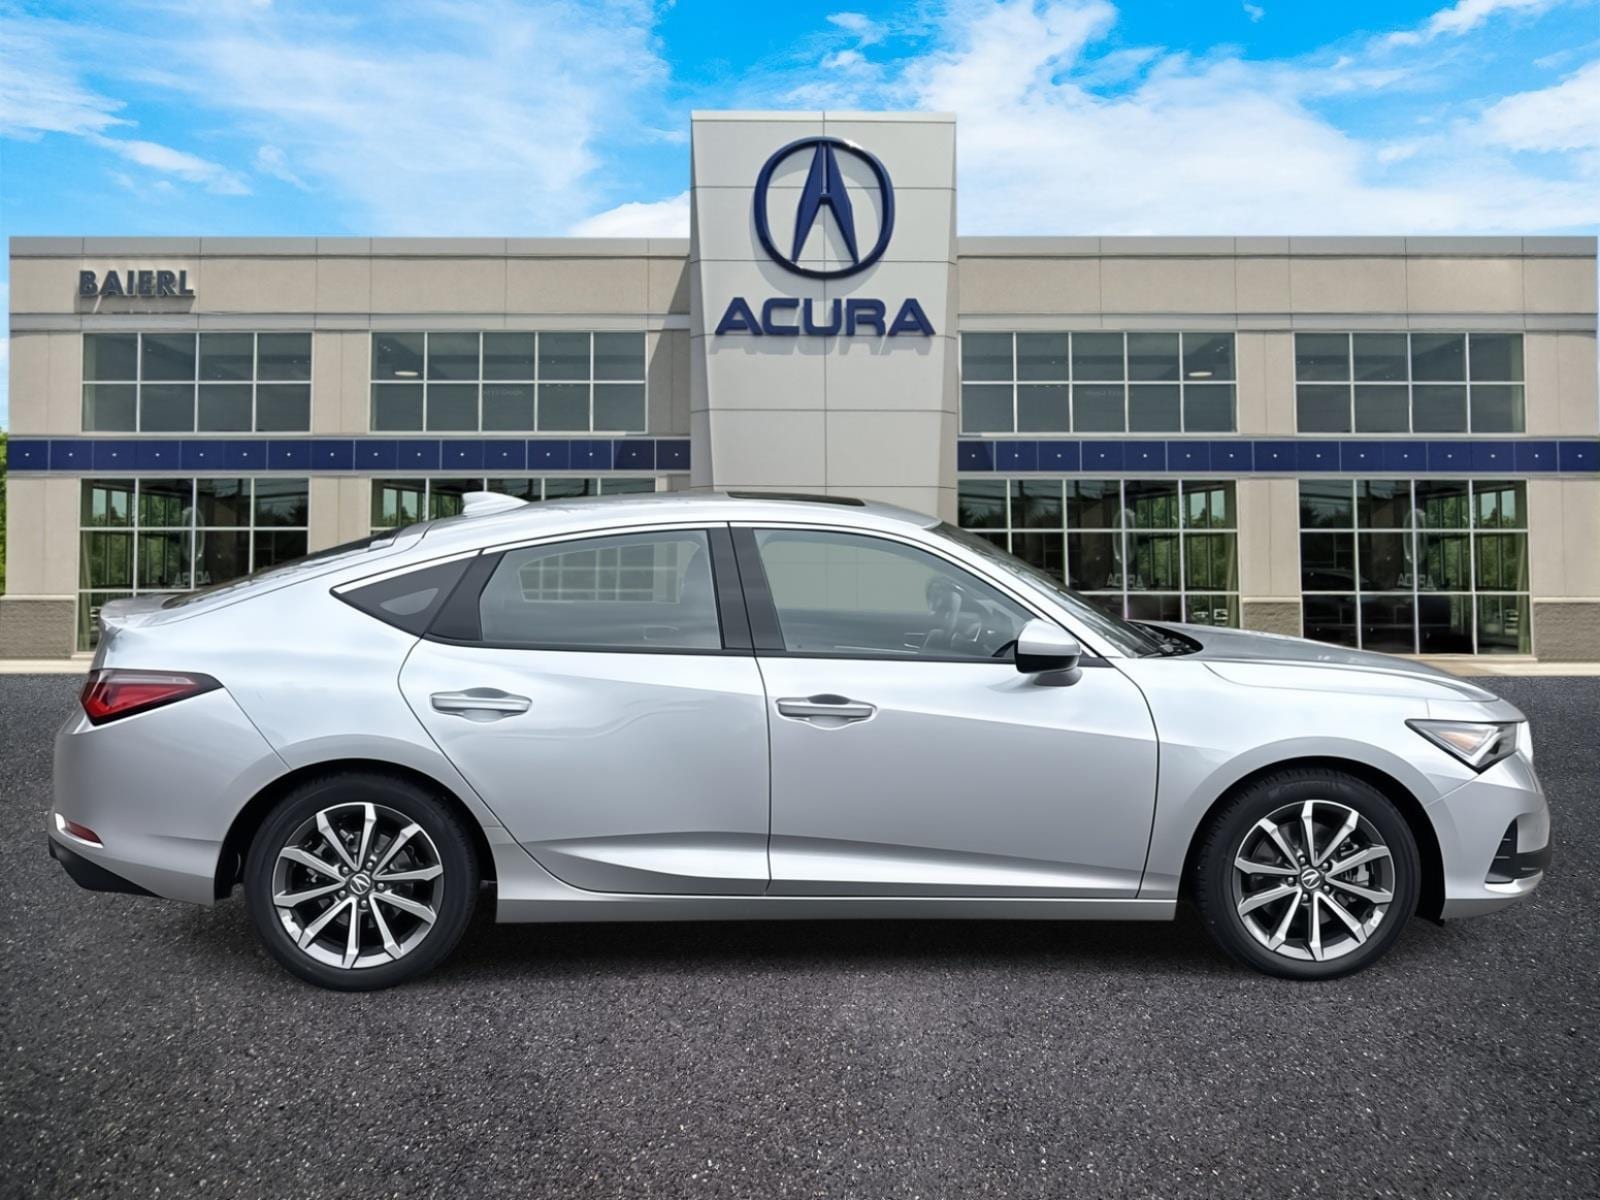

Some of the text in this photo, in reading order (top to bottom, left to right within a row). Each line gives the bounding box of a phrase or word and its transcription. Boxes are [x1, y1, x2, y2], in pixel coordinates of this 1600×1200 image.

[79, 270, 194, 295] BAIERL
[715, 297, 936, 336] ACURA
[1106, 572, 1144, 588] ACRA
[1397, 572, 1435, 587] ACRA
